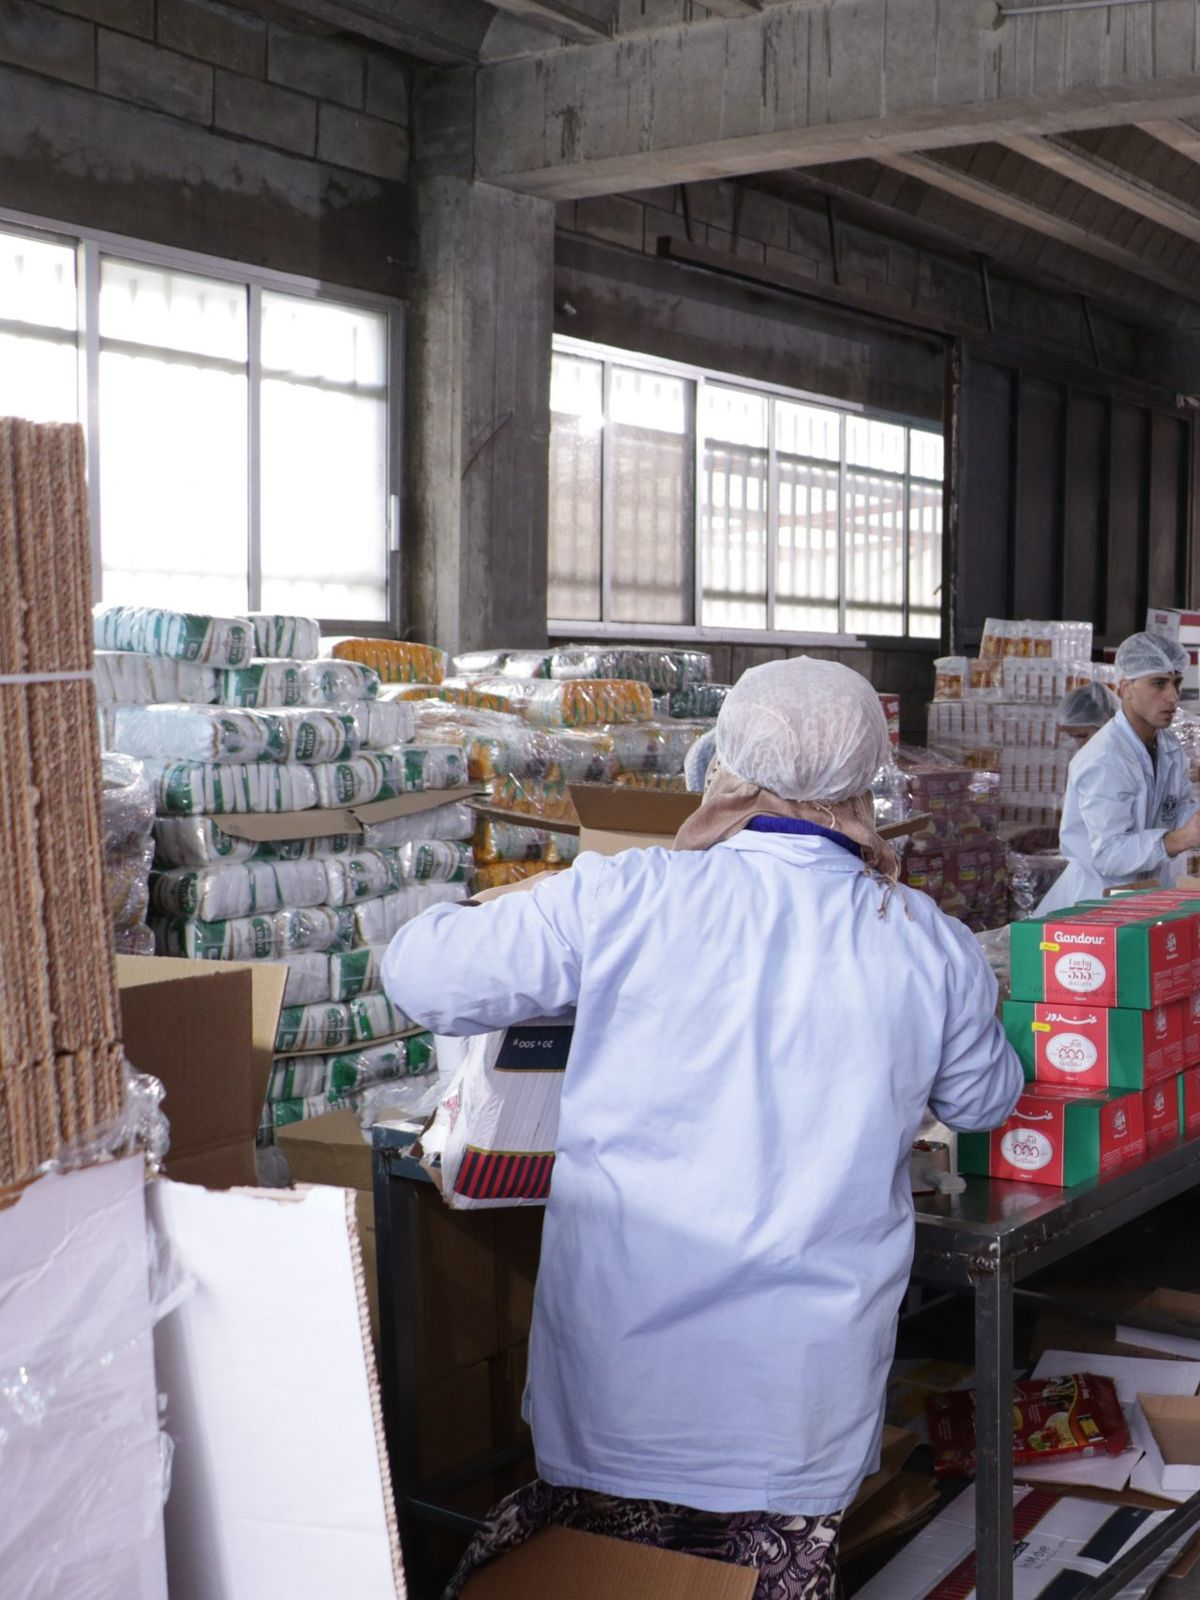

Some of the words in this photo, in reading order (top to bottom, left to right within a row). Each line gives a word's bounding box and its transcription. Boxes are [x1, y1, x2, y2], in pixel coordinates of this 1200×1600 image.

[1054, 931, 1105, 945] Gandour
[1069, 958, 1092, 968] Lucky
[1045, 1012, 1097, 1025] غندور
[519, 1040, 535, 1048] 500
[542, 1040, 553, 1048] 20
